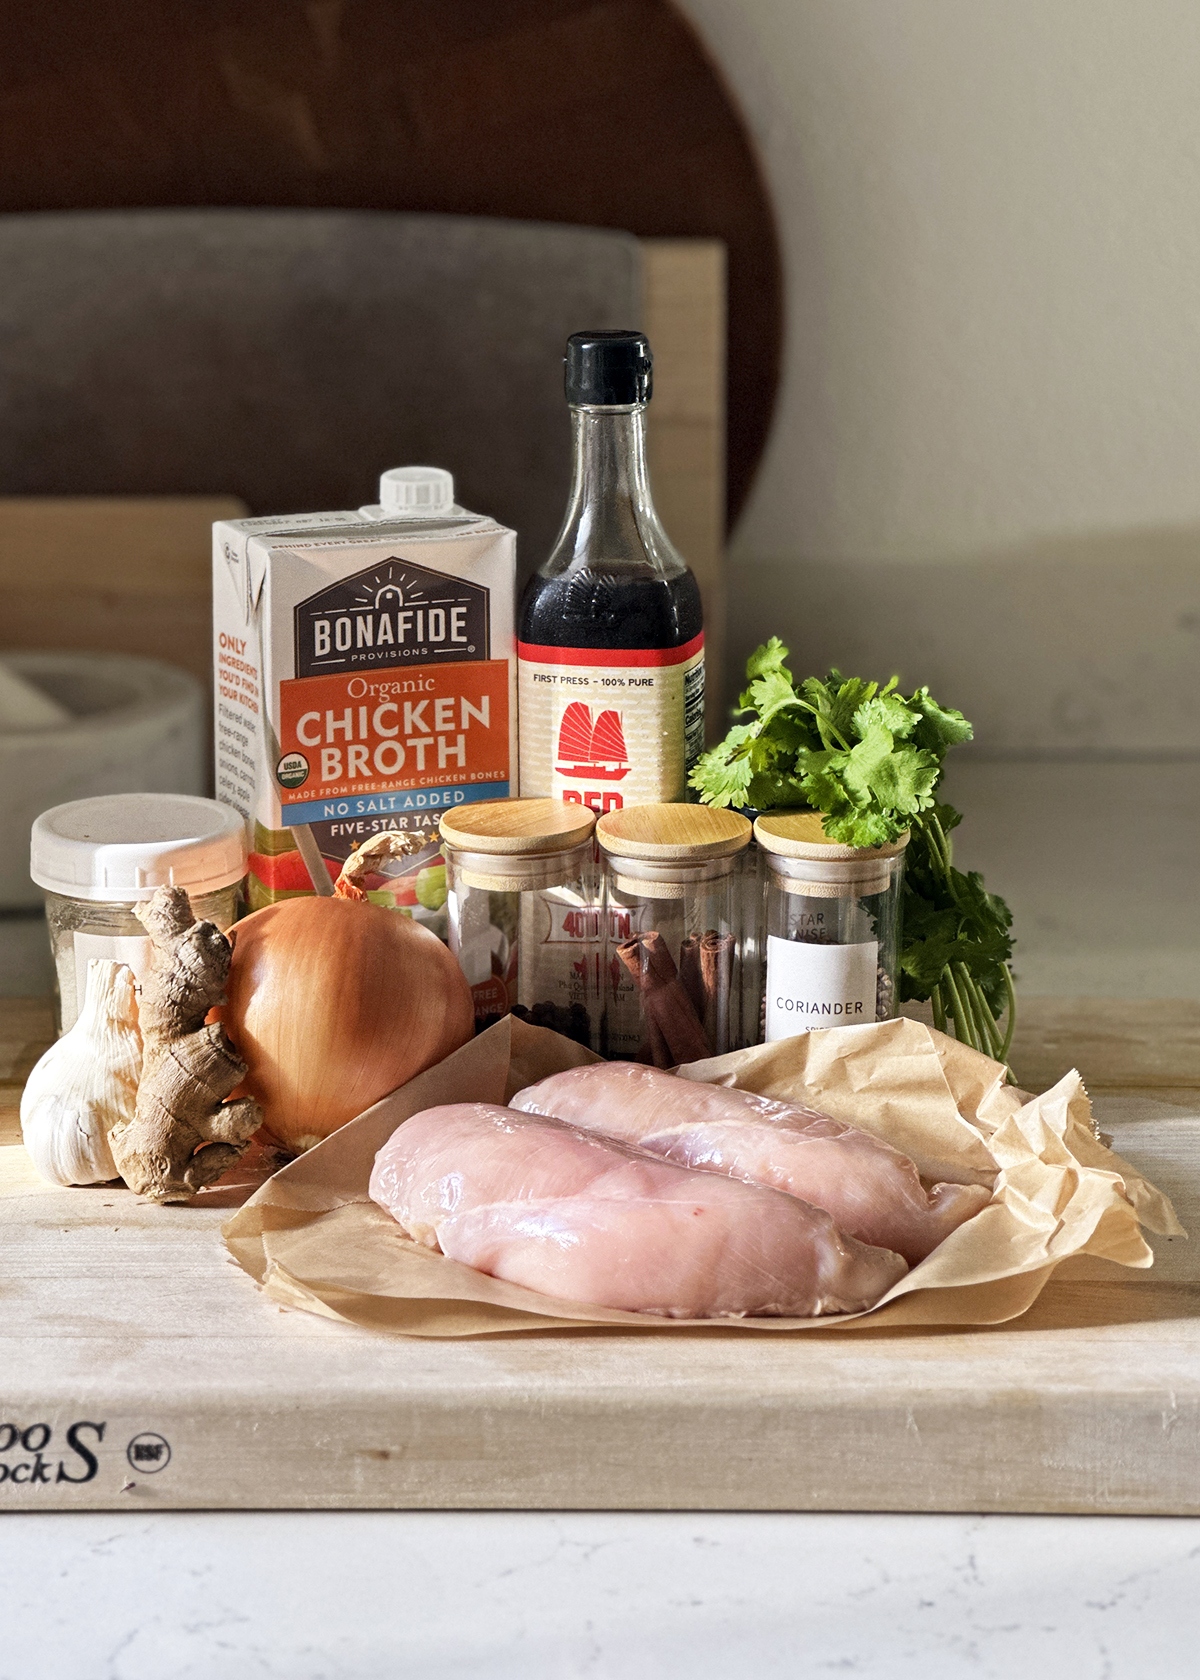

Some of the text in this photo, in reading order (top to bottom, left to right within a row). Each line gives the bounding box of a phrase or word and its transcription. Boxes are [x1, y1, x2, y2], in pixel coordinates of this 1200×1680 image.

[314, 606, 468, 657] BONAFIDE
[219, 632, 247, 656] ONLY
[351, 647, 428, 662] PROVISIONS
[219, 668, 241, 686] YOU'D
[347, 674, 435, 702] Organic
[533, 674, 557, 683] FIRST
[560, 676, 589, 685] PRESS
[601, 678, 625, 686] 100%
[628, 678, 654, 686] PURE
[219, 683, 238, 701] YOUR
[219, 703, 243, 725] Filtered
[296, 696, 490, 747] CHICKEN
[219, 721, 249, 747] free-range
[283, 760, 302, 771] USDA
[321, 735, 466, 782] BROTH
[288, 770, 506, 800] MADE FROM FREE-RANGE CHICKEN BONES
[324, 791, 465, 817] NO SALT ADDED
[330, 814, 443, 837] FIVE-STAR TAS
[789, 913, 825, 926] STAR
[473, 988, 504, 1016] FREE ANGE
[776, 997, 864, 1015] CORIANDER
